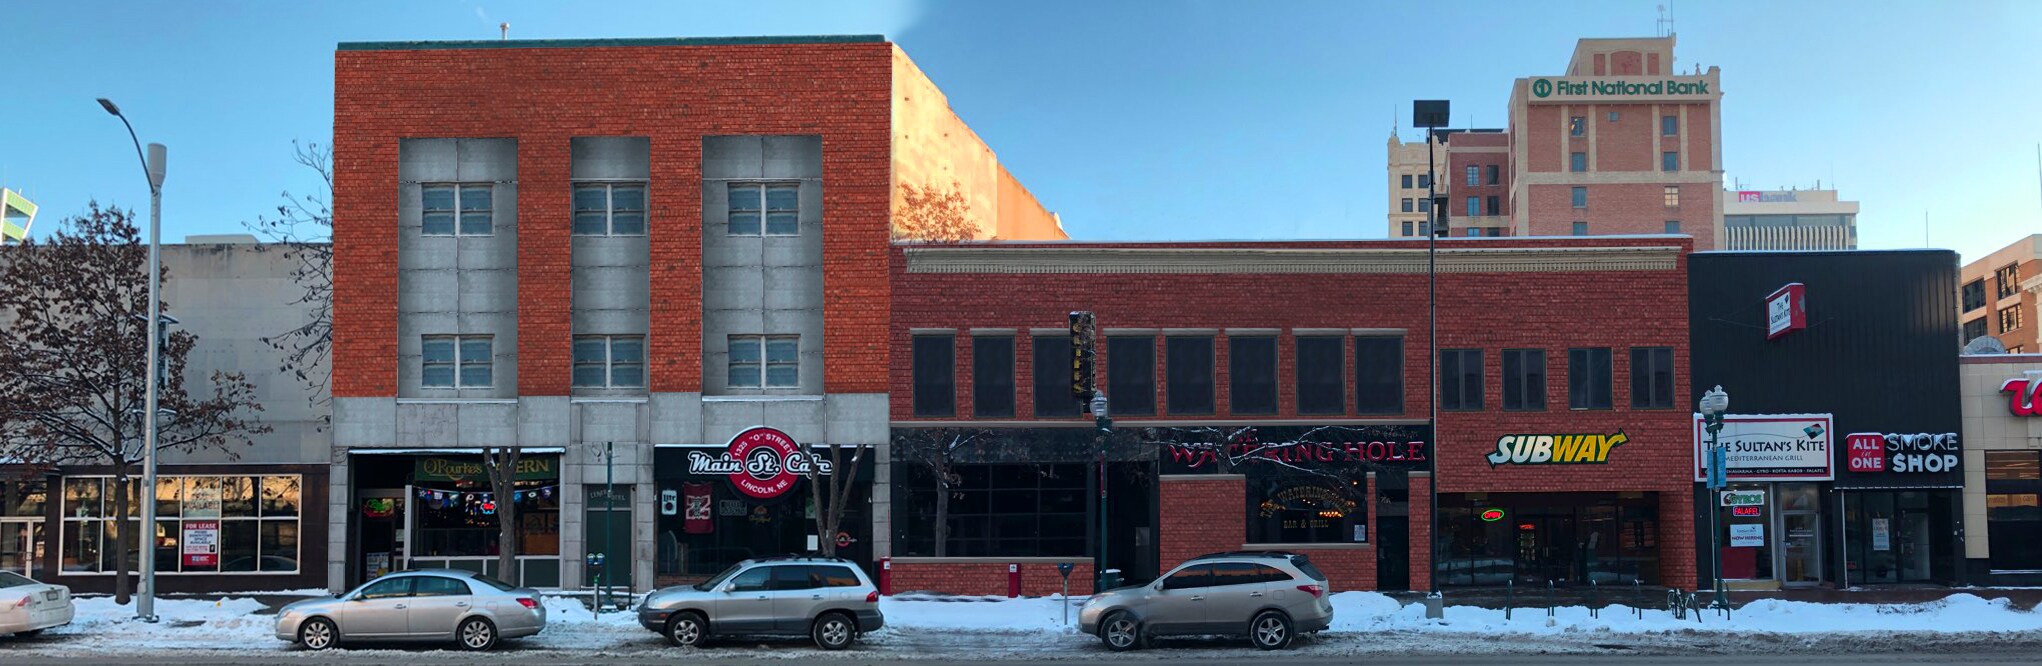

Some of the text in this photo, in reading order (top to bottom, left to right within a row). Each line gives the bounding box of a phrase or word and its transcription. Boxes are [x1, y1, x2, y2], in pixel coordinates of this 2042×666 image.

[1557, 80, 1588, 95] First
[1592, 80, 1662, 95] National
[1667, 80, 1709, 95] Bank
[734, 441, 748, 456] 1325
[766, 433, 793, 453] STREET
[1488, 432, 1627, 464] SUBWAY
[1736, 440, 1792, 452] SULTAN'S
[1796, 440, 1825, 452] KITE
[1853, 438, 1879, 450] ALL
[1887, 433, 1958, 451] SMOKE
[1343, 441, 1426, 461] HOLE
[688, 452, 745, 473] Main
[747, 452, 781, 474] St.
[1852, 457, 1881, 469] ONE
[1893, 454, 1958, 472] SHOP
[776, 480, 787, 489] NE
[1734, 506, 1759, 515] FALAFEL
